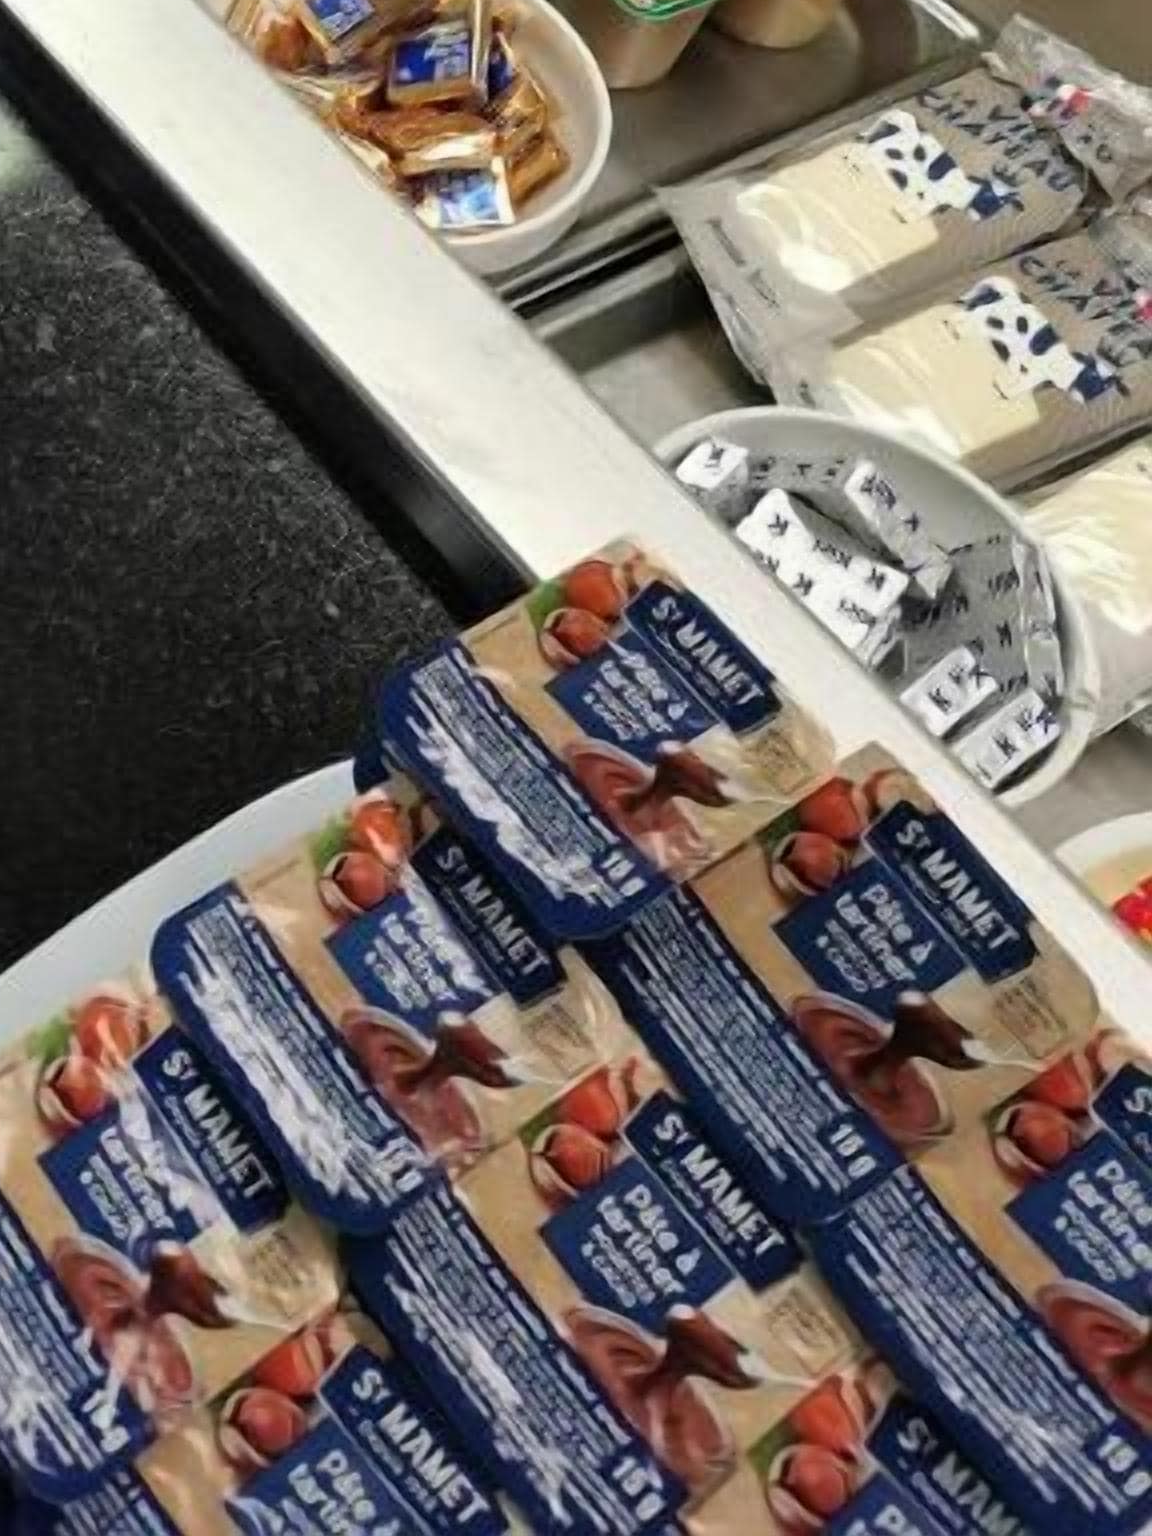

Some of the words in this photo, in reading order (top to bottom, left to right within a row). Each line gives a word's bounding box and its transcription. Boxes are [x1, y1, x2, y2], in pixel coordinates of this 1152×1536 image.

[675, 618, 766, 705] MAMET
[458, 874, 552, 976] MAMET
[920, 848, 1022, 950] MAMET
[183, 1083, 276, 1199] MAMET
[1122, 1086, 1152, 1115] S
[679, 1143, 787, 1257] MAMET
[1067, 1170, 1152, 1268] tartine
[378, 1401, 492, 1524] MAMET
[931, 1451, 1028, 1536] MAM
